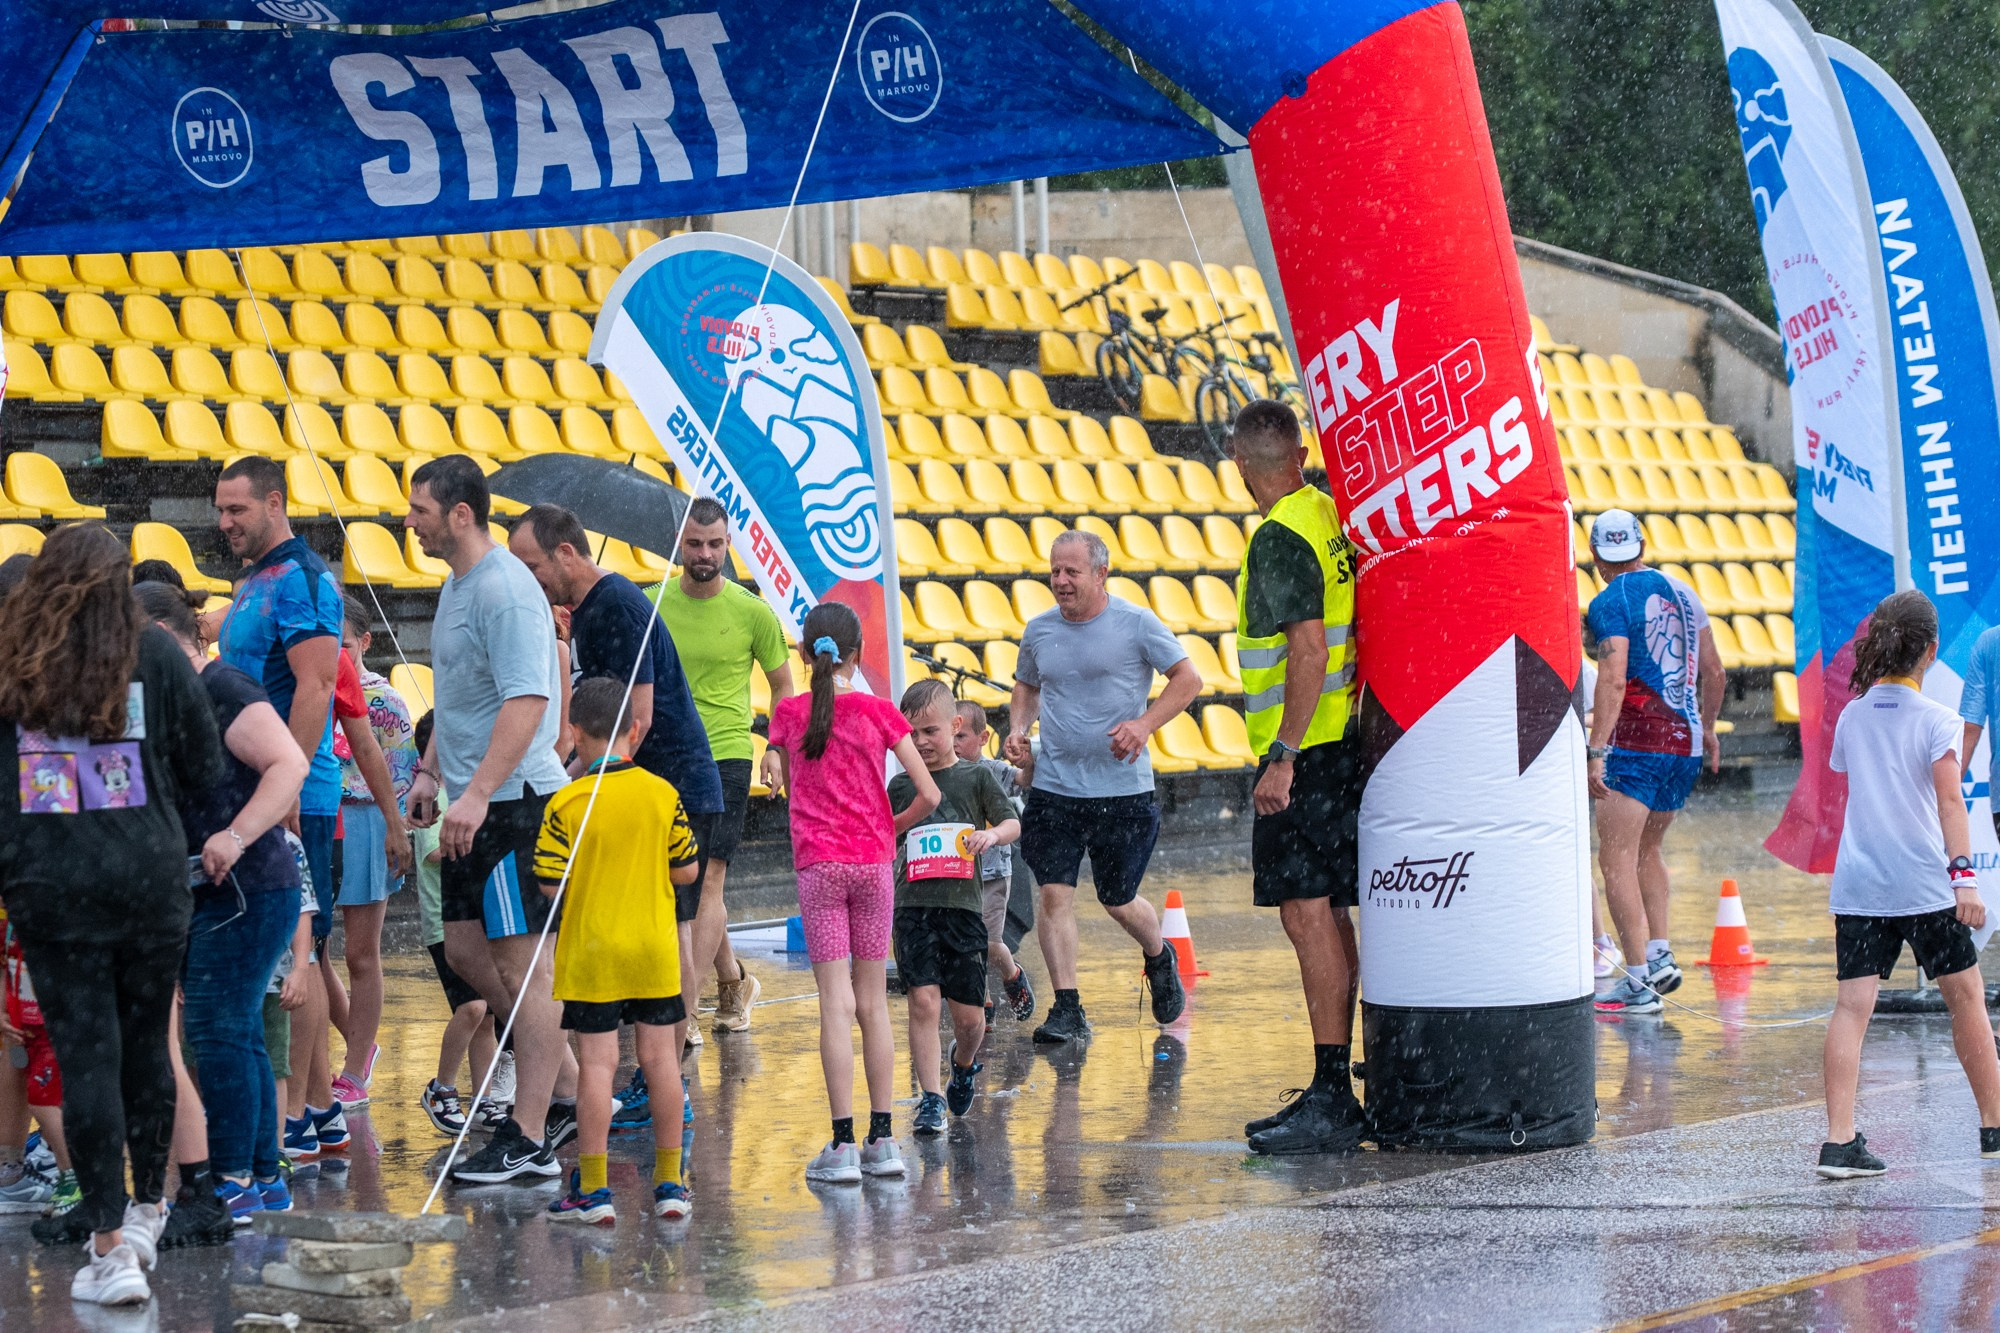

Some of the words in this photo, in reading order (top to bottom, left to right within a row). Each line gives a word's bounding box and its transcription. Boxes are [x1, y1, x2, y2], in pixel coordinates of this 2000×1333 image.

[889, 34, 900, 42] IN
[878, 83, 930, 97] MARKOVO
[201, 107, 213, 116] IN
[329, 12, 748, 207] START
[192, 152, 242, 163] MARKOVO
[1304, 298, 1399, 434] ERY
[1336, 338, 1486, 499] STEP
[1677, 590, 1697, 652] MATTERS
[919, 835, 943, 854] 10
[1376, 897, 1421, 909] STUDIO
